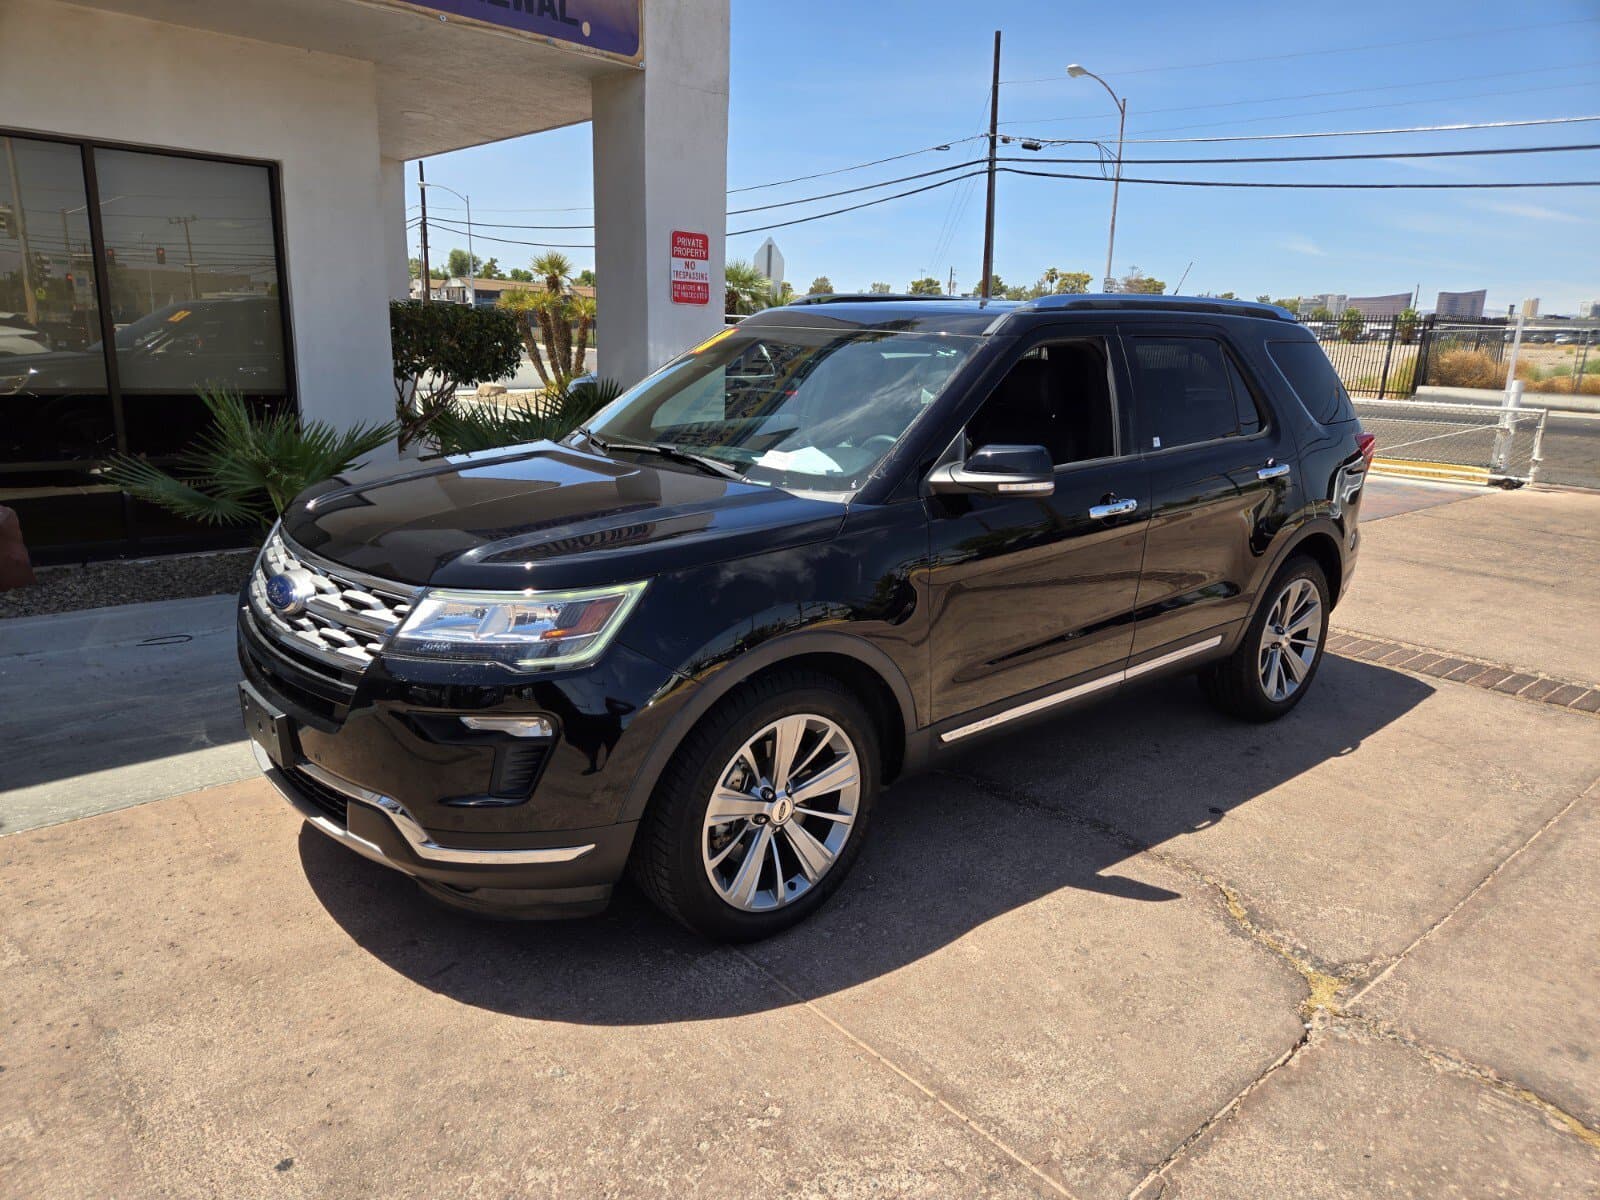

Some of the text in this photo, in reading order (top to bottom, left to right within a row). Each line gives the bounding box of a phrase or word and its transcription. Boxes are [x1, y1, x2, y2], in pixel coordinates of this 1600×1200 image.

[677, 236, 704, 249] PRIVATE
[673, 246, 707, 259] PROPERTY
[684, 261, 696, 270] NO
[673, 270, 708, 281] TRESPASSING
